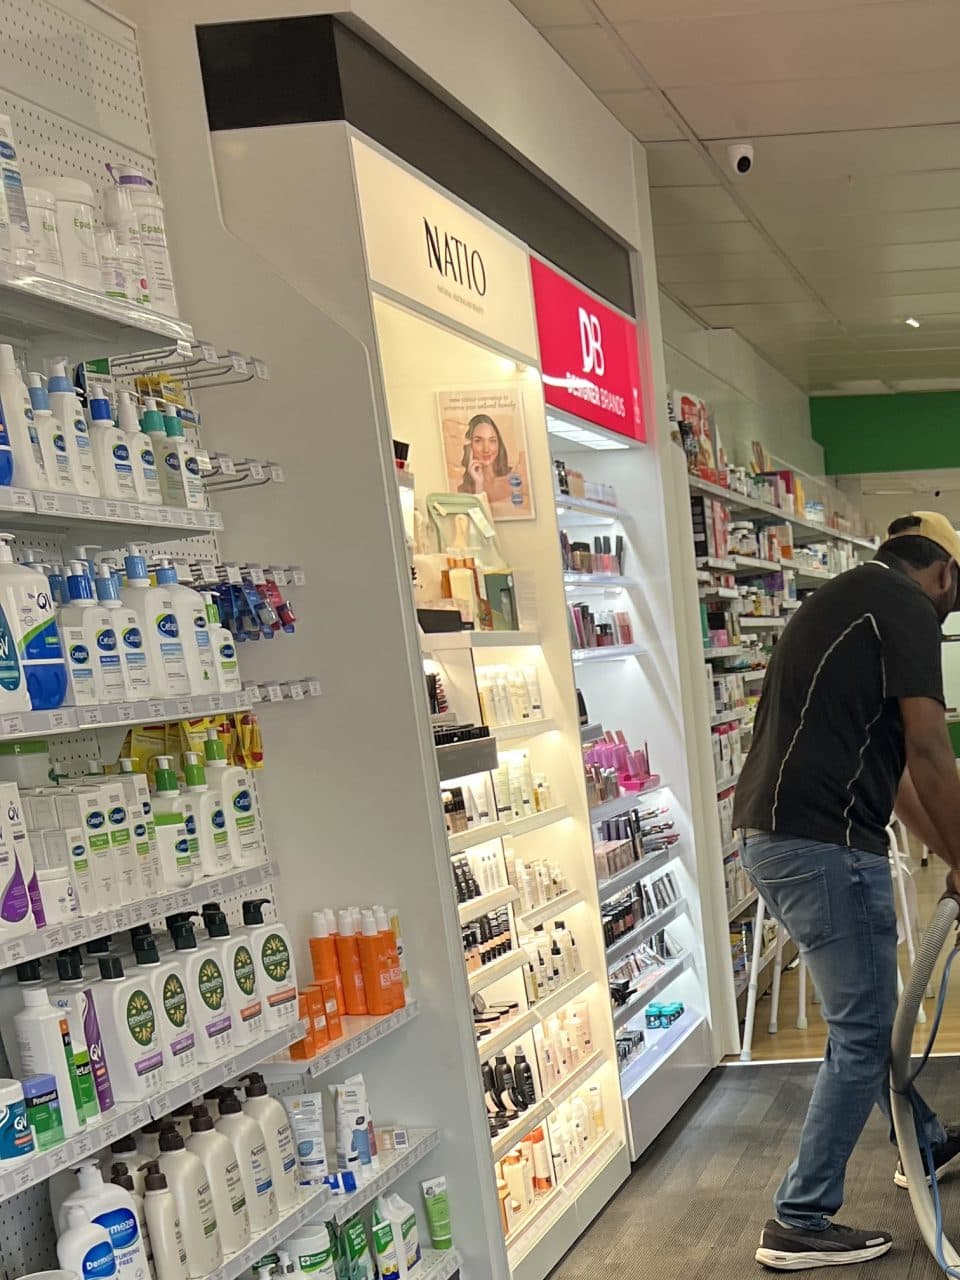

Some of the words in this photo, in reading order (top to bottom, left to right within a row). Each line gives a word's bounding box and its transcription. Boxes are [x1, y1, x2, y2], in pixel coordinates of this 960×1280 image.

[423, 216, 487, 297] NATIO
[578, 307, 605, 376] DB
[90, 1041, 103, 1061] QV
[14, 1113, 28, 1130] QV
